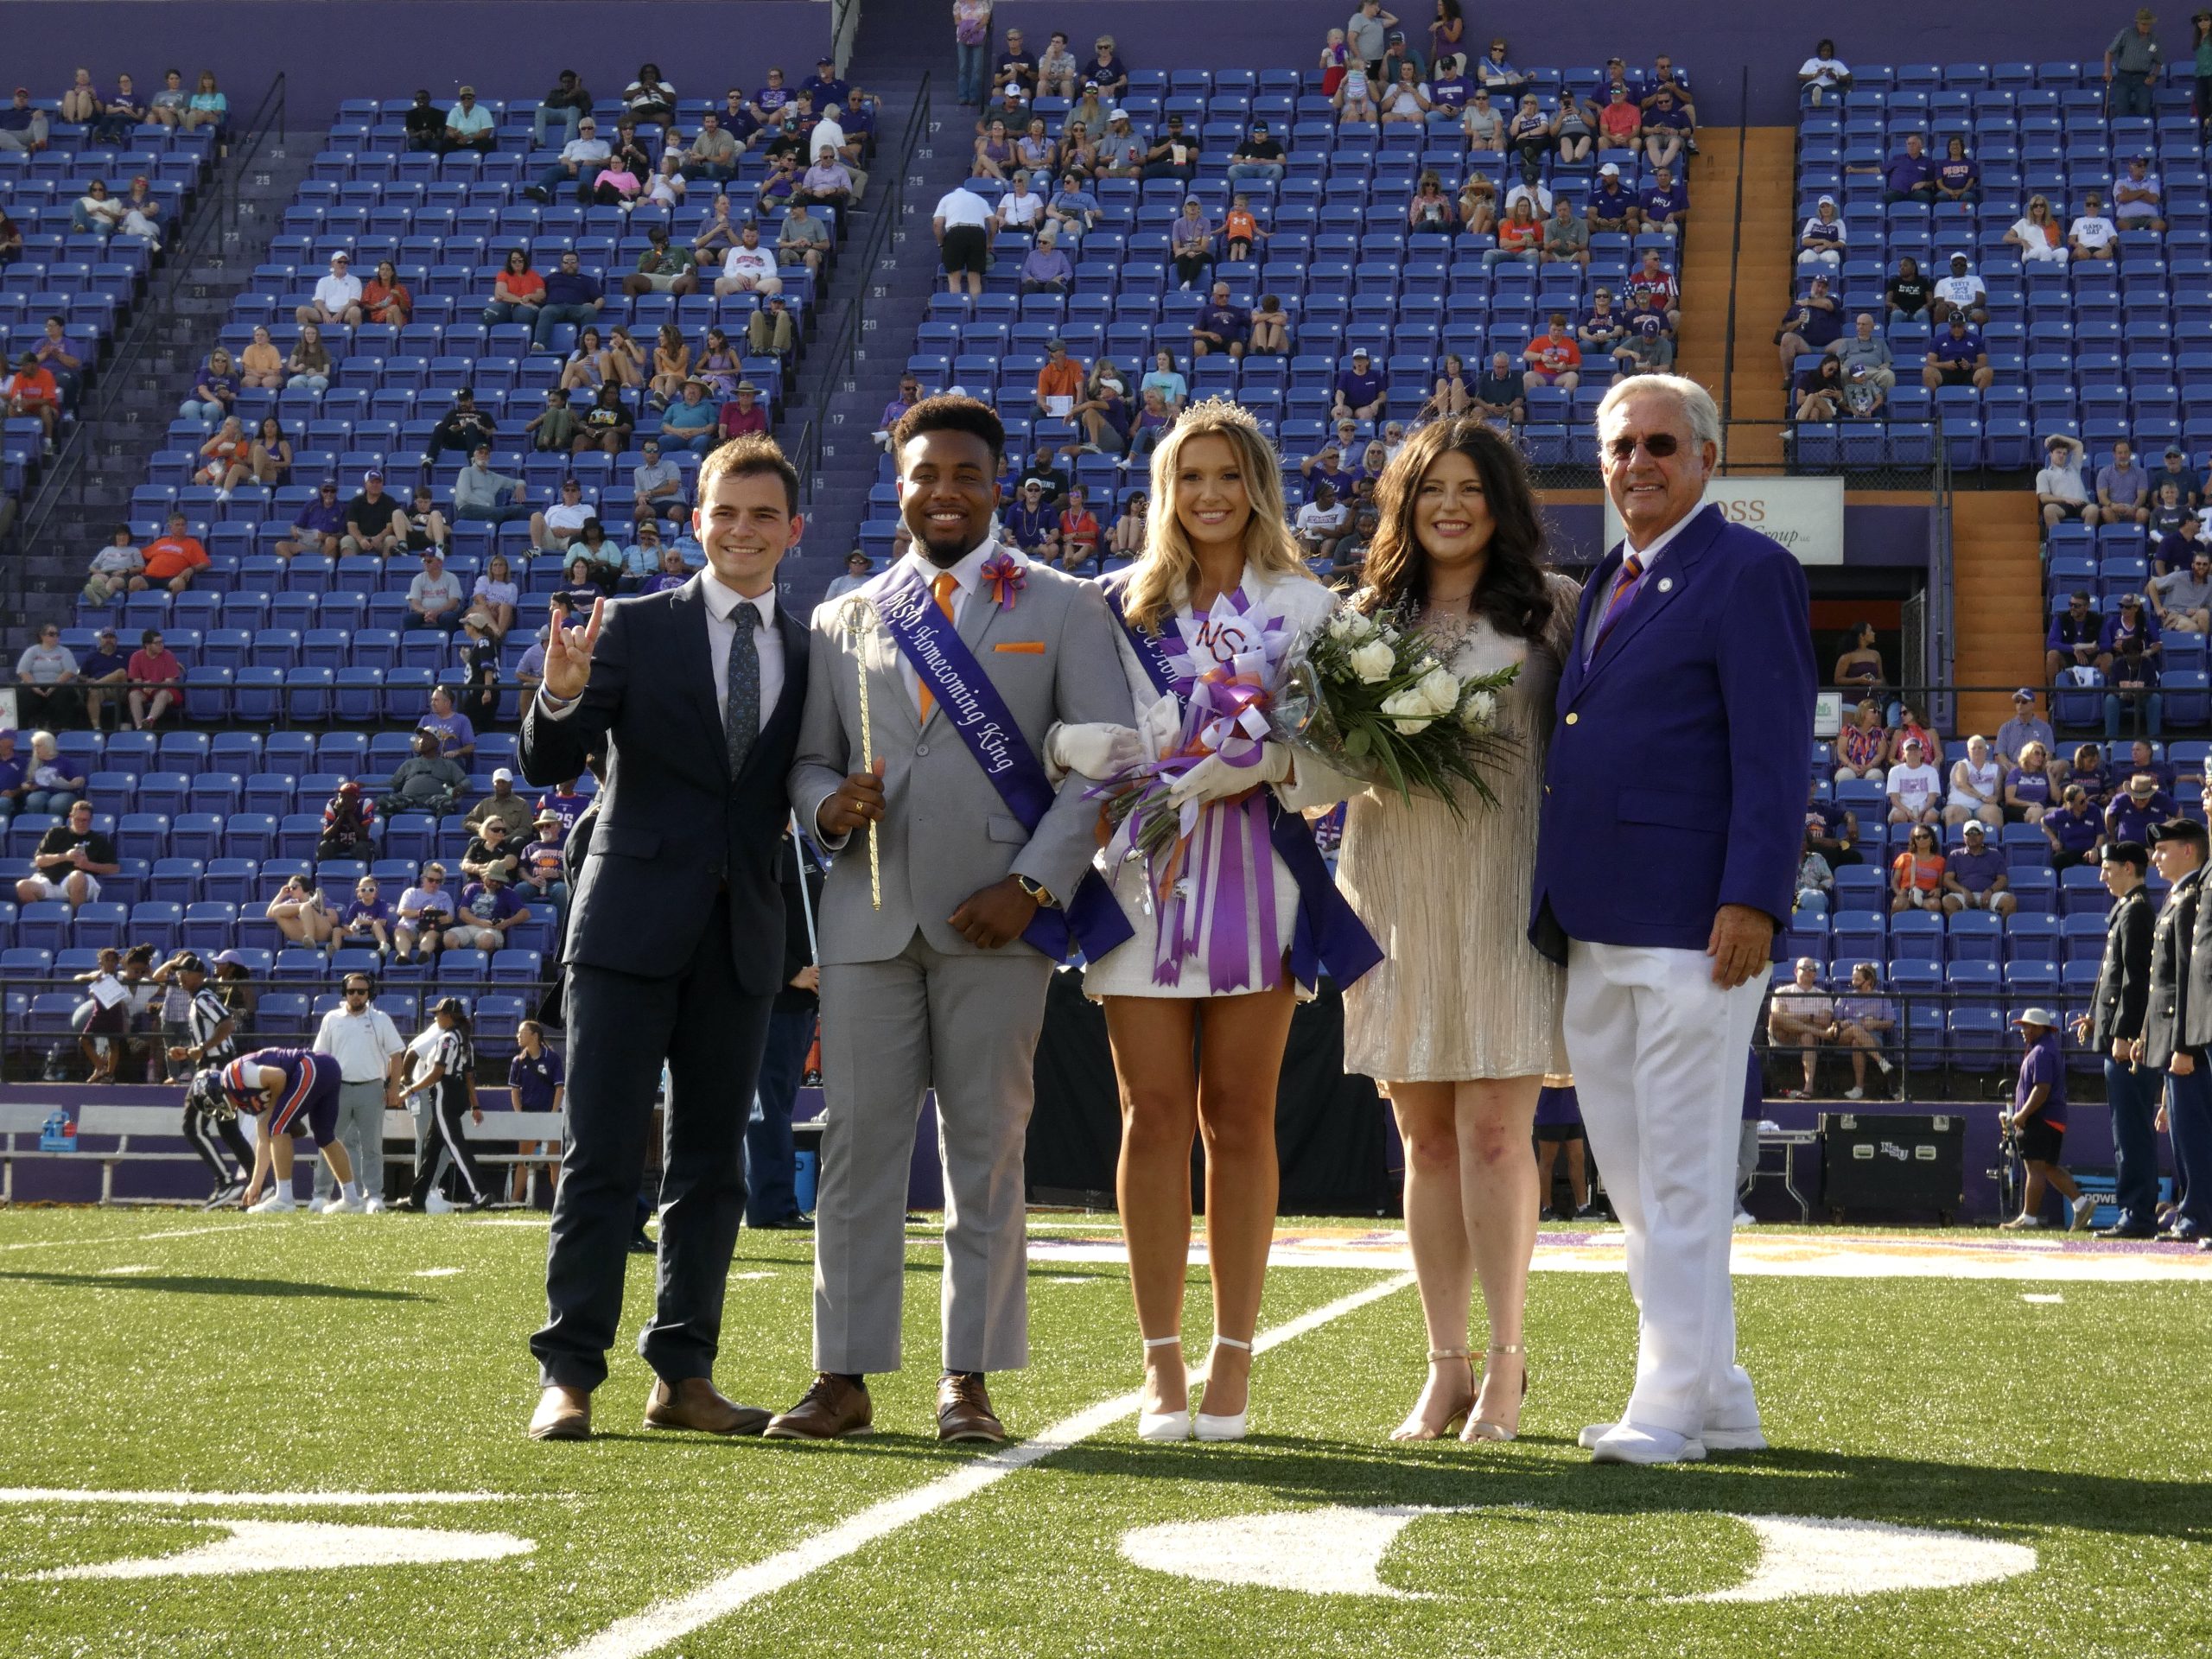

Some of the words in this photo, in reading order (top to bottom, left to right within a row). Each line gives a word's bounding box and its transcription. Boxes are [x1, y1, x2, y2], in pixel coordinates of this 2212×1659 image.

[928, 122, 942, 132] 27
[918, 149, 932, 159] 26
[256, 175, 270, 185] 25
[909, 176, 924, 187] 25
[1652, 196, 1672, 207] NSU
[238, 204, 254, 214] 24
[901, 205, 915, 214] 24
[893, 232, 906, 242] 23
[881, 260, 896, 270] 22
[874, 287, 887, 297] 21
[862, 320, 877, 330] 20
[854, 350, 866, 360] 19
[843, 382, 855, 392] 18
[127, 412, 138, 423] 17
[833, 414, 845, 424] 17
[823, 446, 835, 456] 16
[812, 478, 824, 489] 15
[789, 546, 802, 558] 13
[779, 582, 791, 594] 12
[478, 639, 490, 649] 29
[909, 626, 986, 727] Homecoming
[976, 722, 1014, 773] King
[340, 832, 357, 845] 25
[1880, 1141, 1910, 1161] NSU
